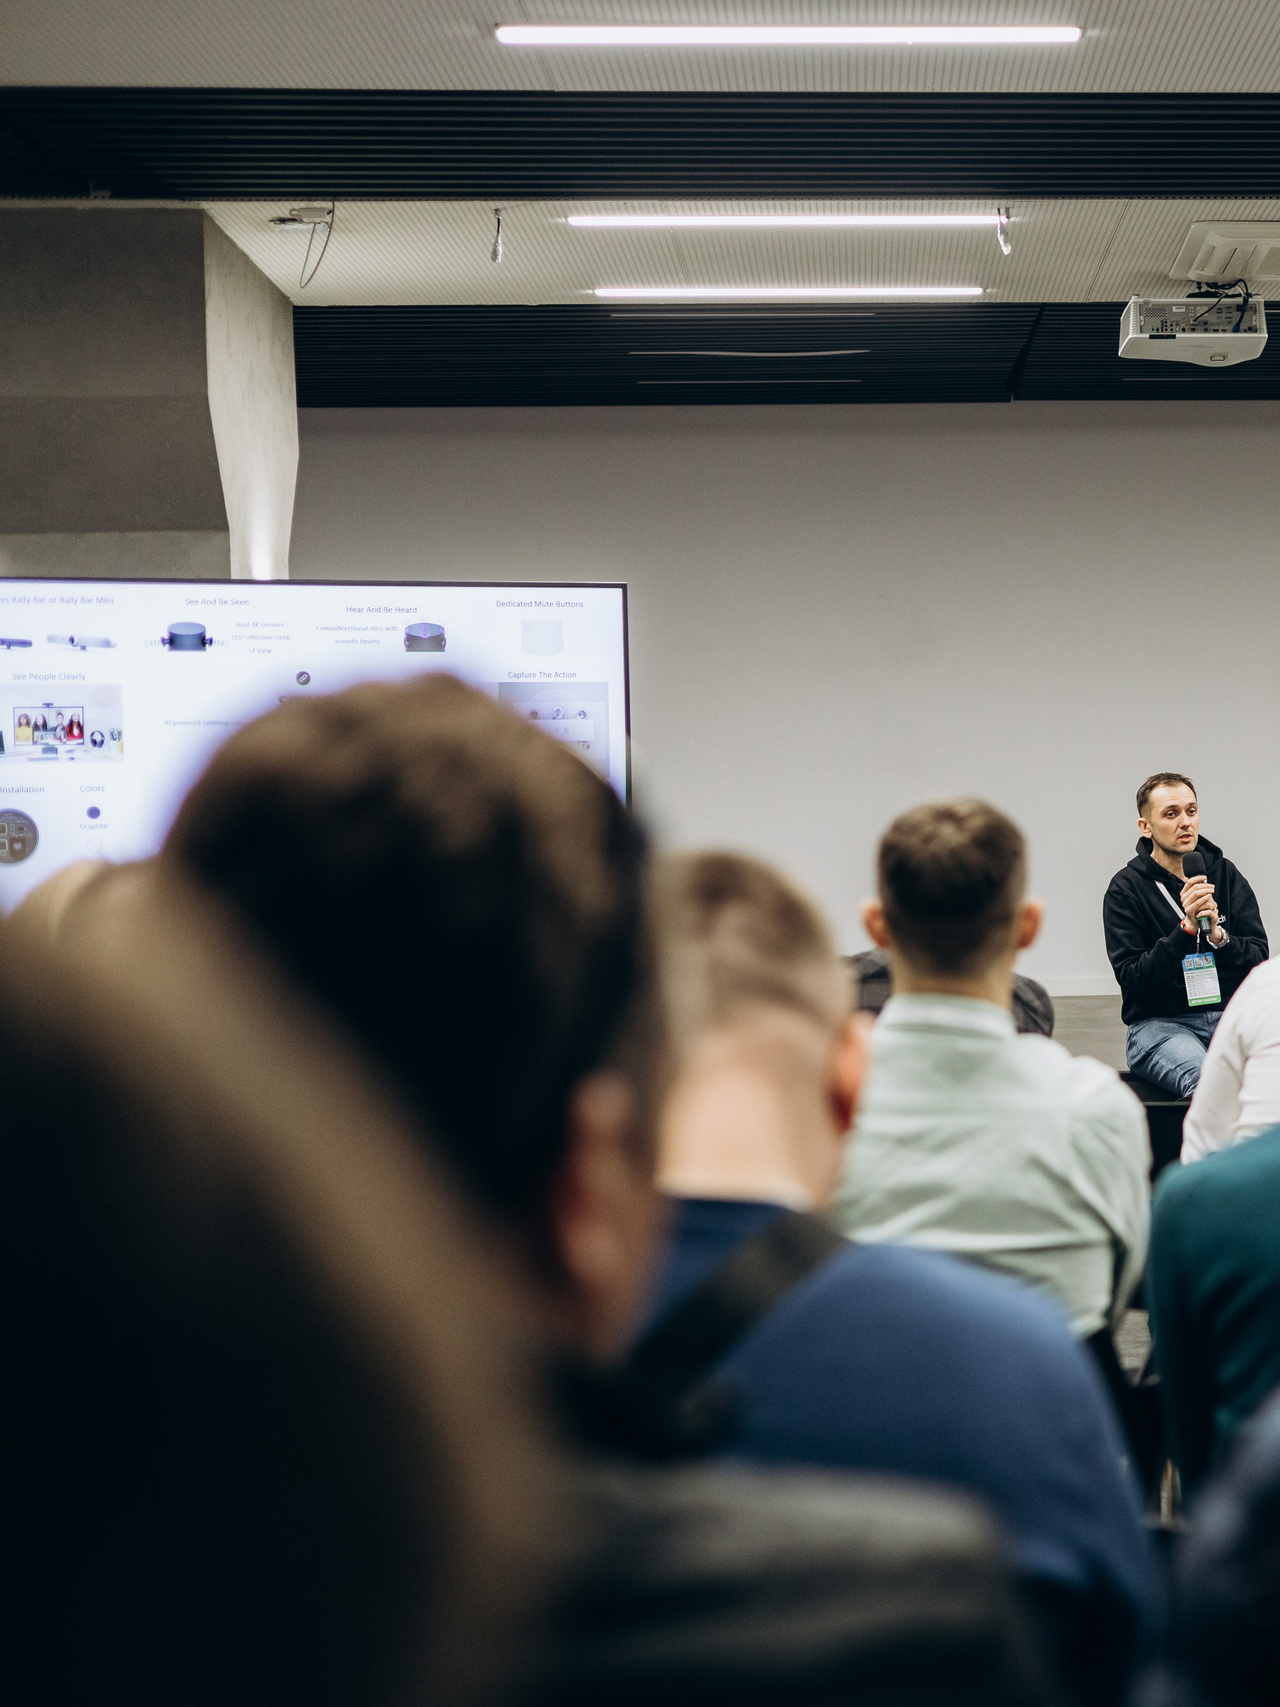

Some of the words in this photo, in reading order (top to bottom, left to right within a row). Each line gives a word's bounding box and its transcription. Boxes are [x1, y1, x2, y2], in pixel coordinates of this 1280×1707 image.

[12, 596, 31, 605] Rally
[33, 596, 46, 604] Bar
[60, 596, 79, 605] Rally
[80, 596, 93, 604] Bar
[96, 596, 114, 604] Mini
[496, 600, 532, 608] Dedicated
[555, 600, 584, 608] Buttons
[395, 606, 418, 614] Heard
[12, 673, 27, 681] See
[29, 673, 56, 682] People
[59, 673, 86, 682] Clearly
[508, 671, 537, 680] Capture
[554, 671, 577, 679] Action
[80, 784, 105, 792] Colors
[80, 823, 108, 831] Graphite
